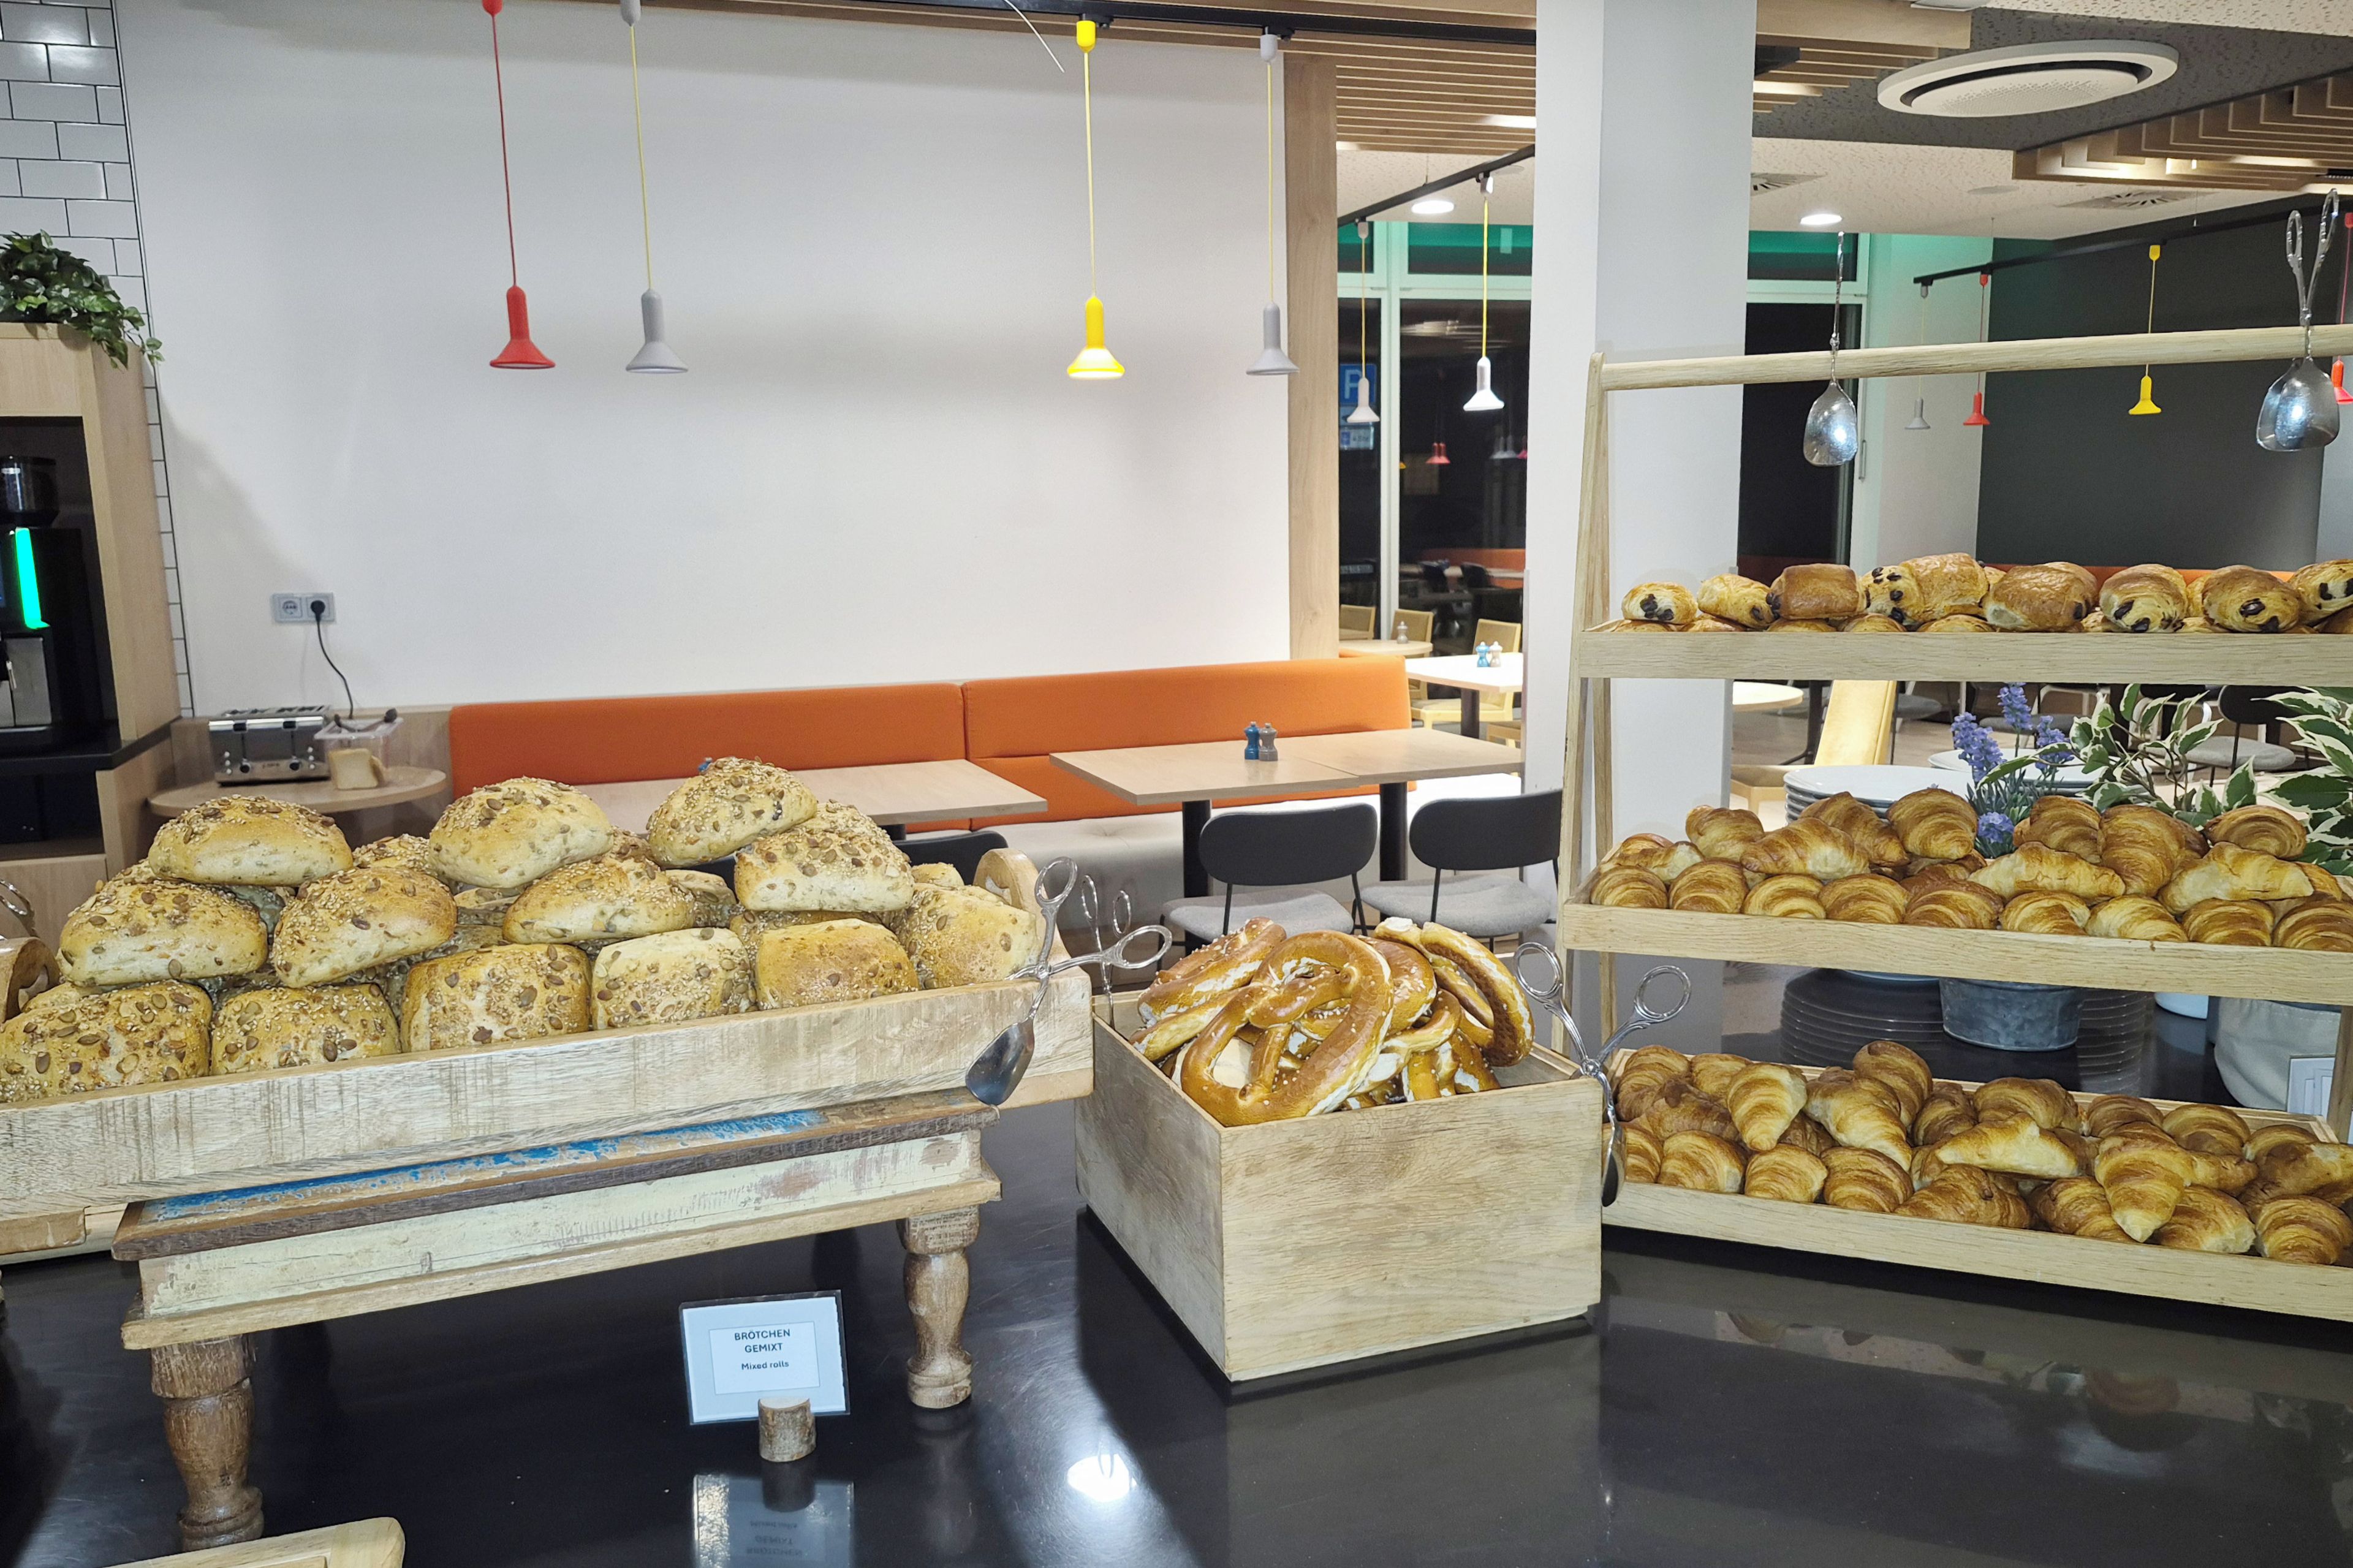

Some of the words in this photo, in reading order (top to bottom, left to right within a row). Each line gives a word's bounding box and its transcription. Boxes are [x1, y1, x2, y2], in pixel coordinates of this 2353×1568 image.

[735, 1328, 790, 1341] BRÖTCHEN
[745, 1343, 782, 1353] GEMIXT
[741, 1362, 767, 1370] Mixed
